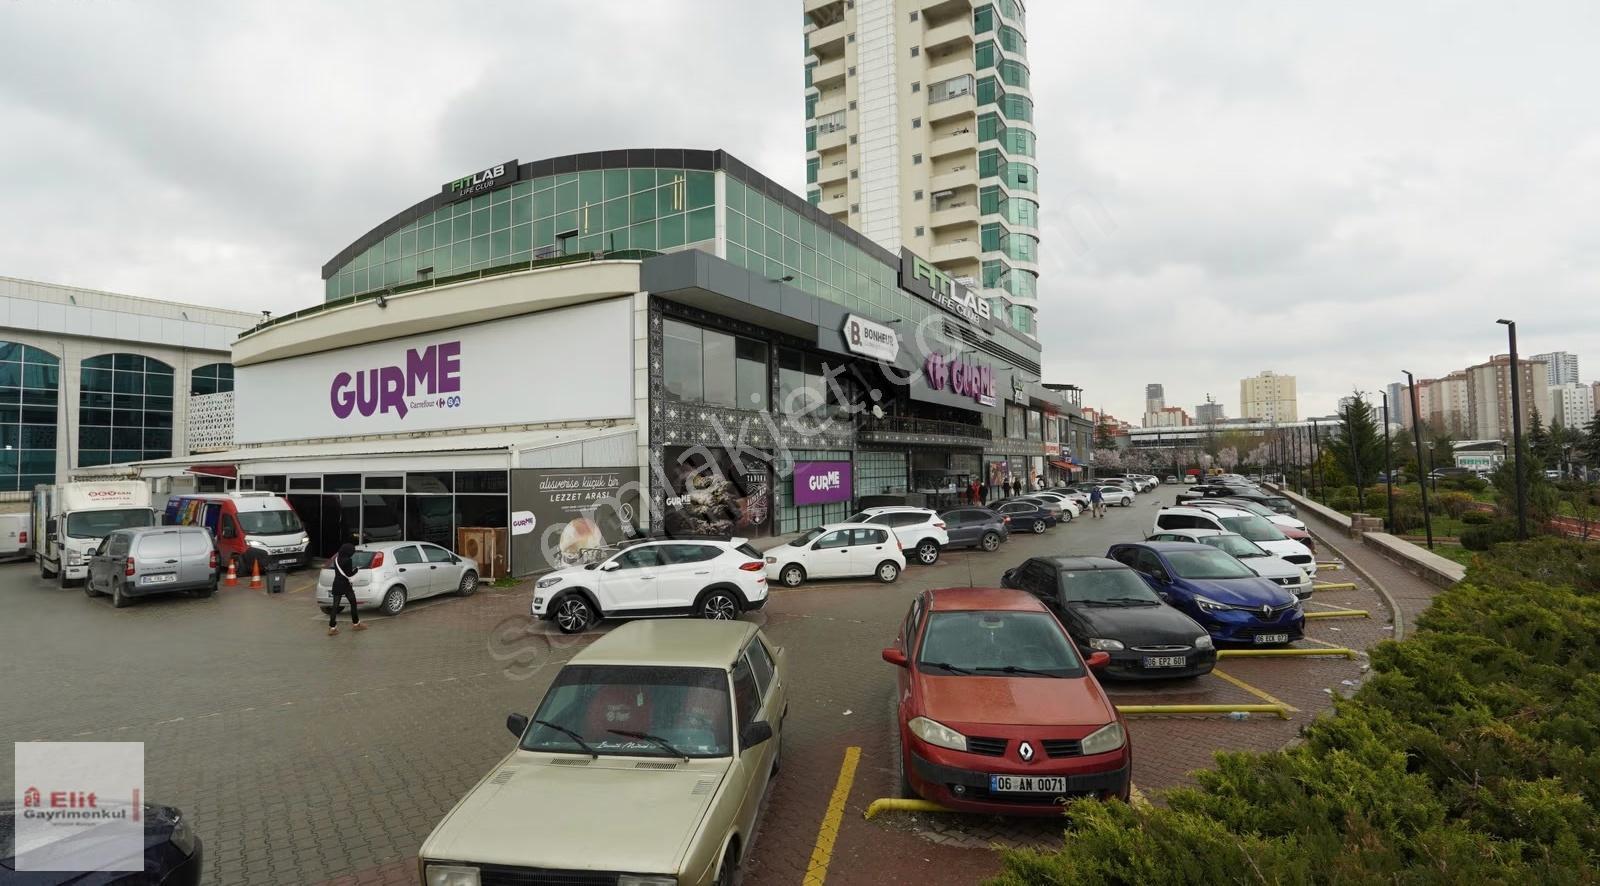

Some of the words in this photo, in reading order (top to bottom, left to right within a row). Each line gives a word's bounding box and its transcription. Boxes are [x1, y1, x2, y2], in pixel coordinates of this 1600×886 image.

[451, 165, 505, 192] FITLAB
[460, 187, 474, 196] LIFE
[475, 180, 494, 191] CLUB
[912, 256, 991, 321] FITLAB
[931, 289, 955, 309] LIFE
[956, 300, 981, 323] CLUB
[331, 341, 461, 420] GURME
[951, 359, 997, 398] GURME
[809, 471, 840, 491] GURME
[550, 492, 581, 502] LEZZET
[585, 491, 610, 501] ARASI
[666, 494, 690, 506] GURME
[513, 517, 533, 527] GURME
[998, 778, 1012, 791] 06
[1019, 778, 1033, 791] AN
[1038, 778, 1063, 791] 0071
